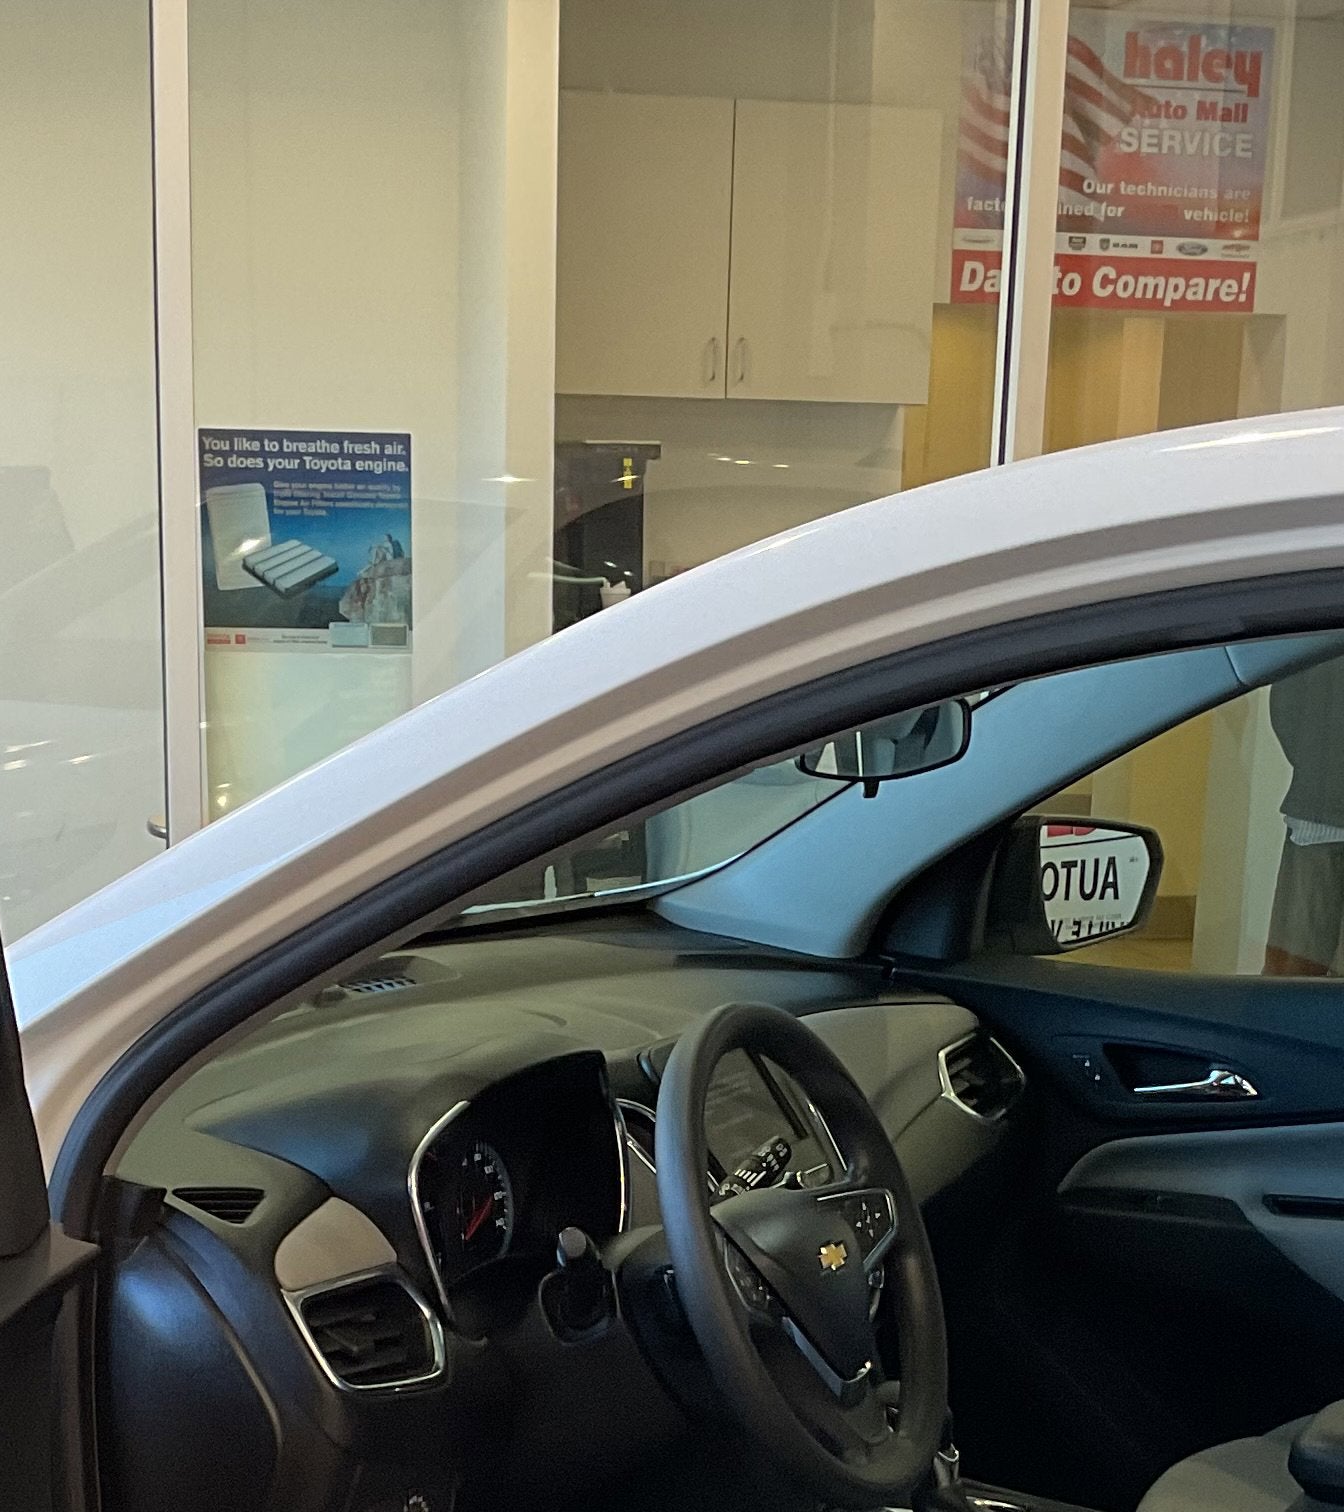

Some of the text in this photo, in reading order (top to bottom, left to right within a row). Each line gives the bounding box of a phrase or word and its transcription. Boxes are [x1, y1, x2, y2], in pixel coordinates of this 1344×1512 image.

[1123, 31, 1263, 98] haley
[1196, 101, 1248, 123] Mall
[1120, 127, 1253, 158] SERVICE
[1083, 179, 1251, 200] Our technicians are
[1100, 201, 1126, 217] for
[1184, 209, 1250, 223] vehicle!
[1092, 267, 1251, 307] Compare!
[202, 436, 406, 456] You like to breathe fresh air.
[203, 454, 409, 474] So does your Toyota engine.
